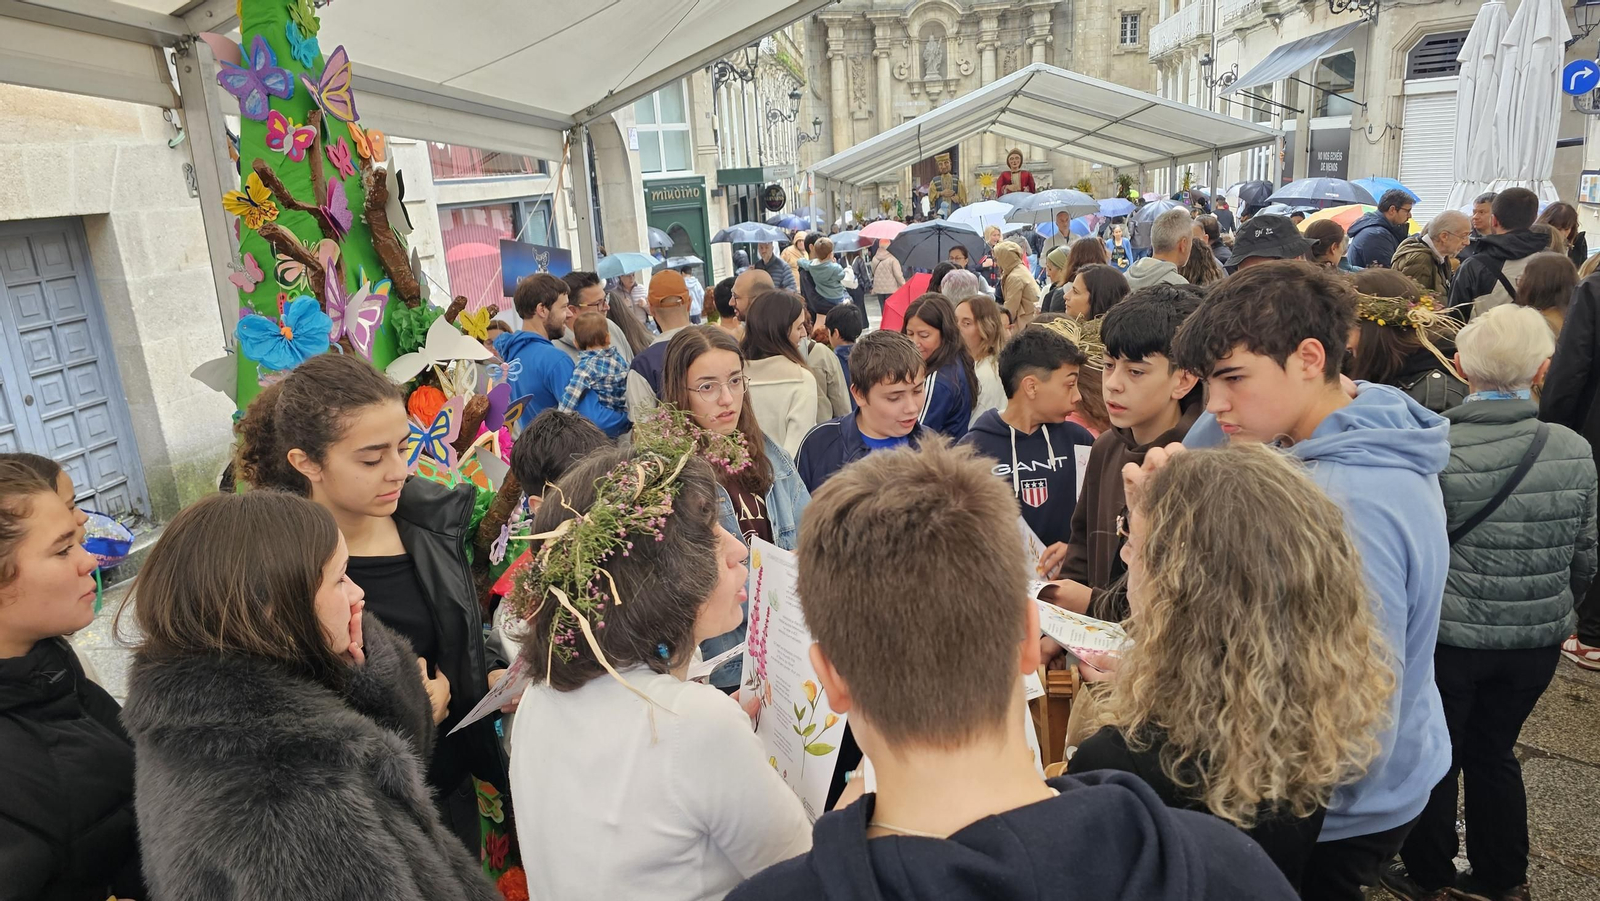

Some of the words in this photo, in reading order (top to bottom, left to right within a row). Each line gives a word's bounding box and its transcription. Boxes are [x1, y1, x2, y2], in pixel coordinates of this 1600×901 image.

[1320, 162, 1326, 171] DE
[1325, 162, 1338, 172] MENOS
[991, 456, 1068, 476] GANT
